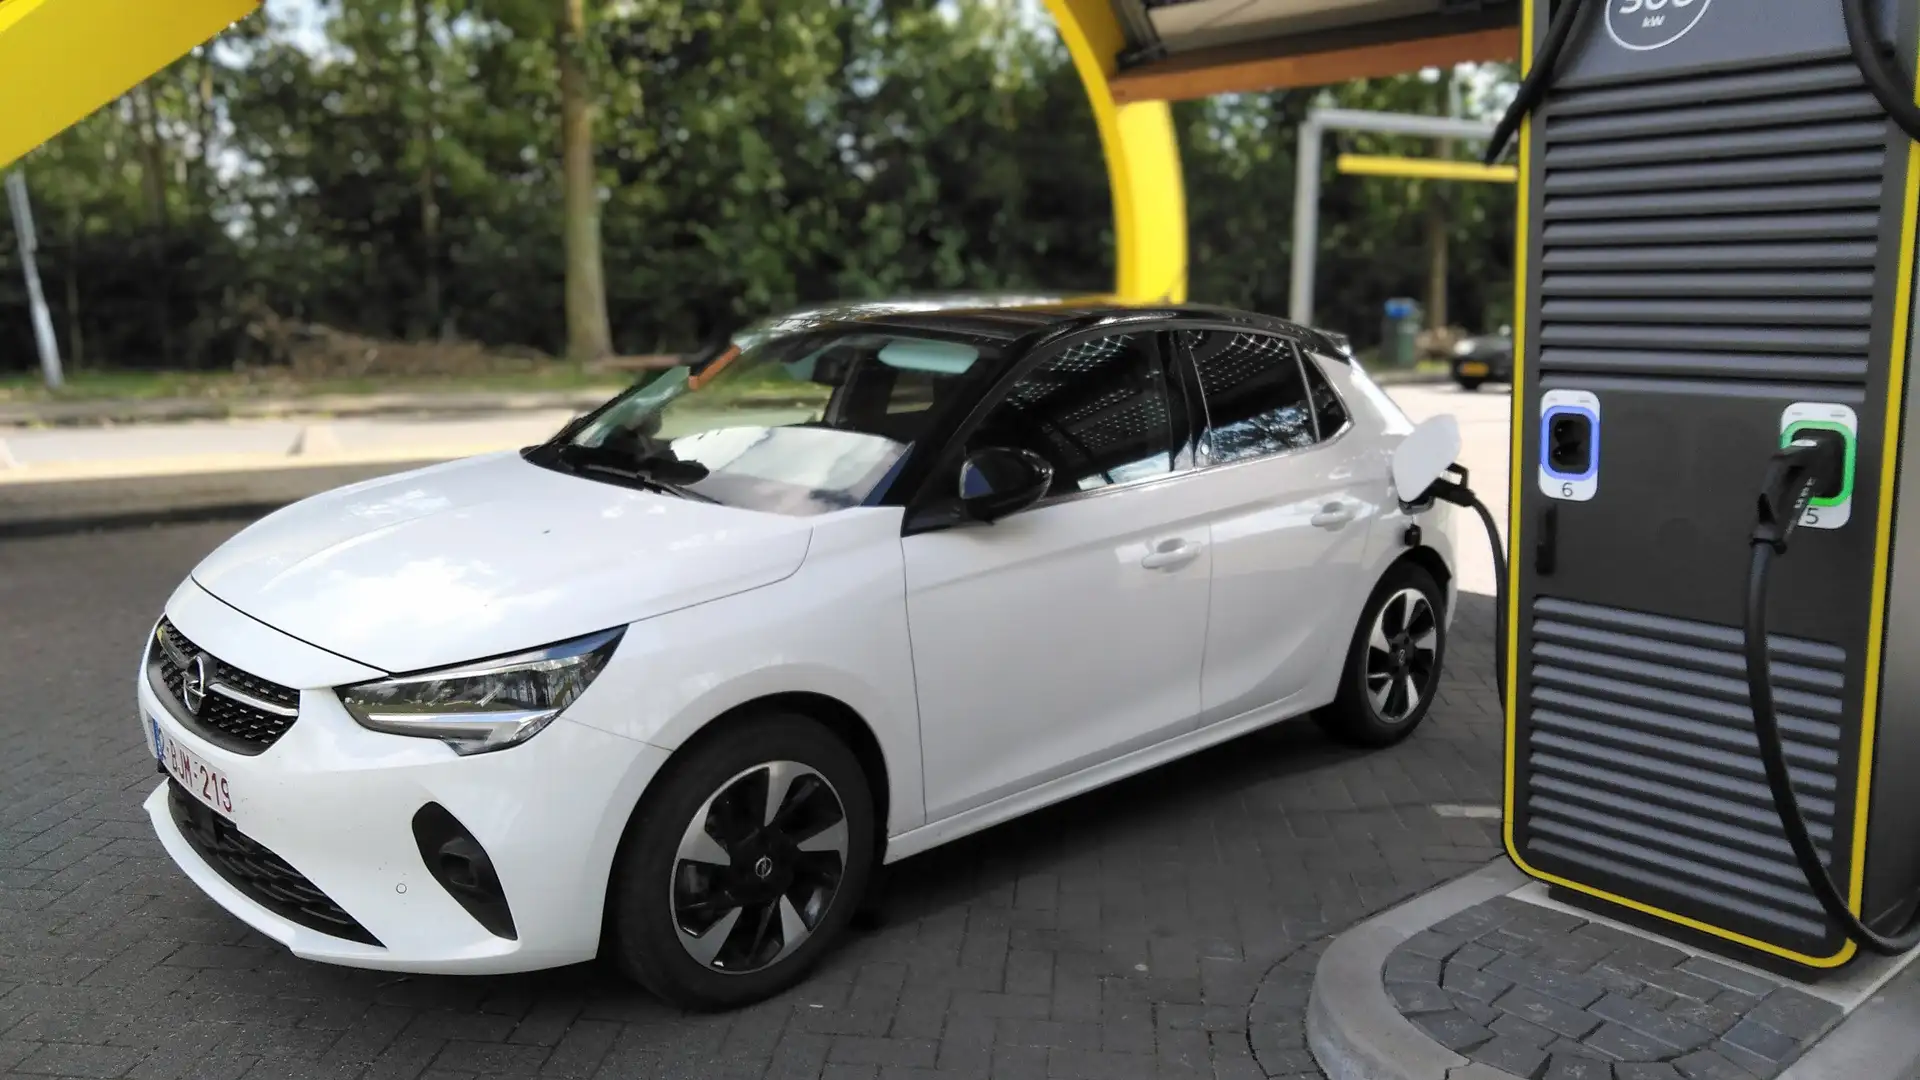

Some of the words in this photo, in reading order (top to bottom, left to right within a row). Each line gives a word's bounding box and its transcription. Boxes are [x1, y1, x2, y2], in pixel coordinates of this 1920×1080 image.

[1641, 14, 1666, 28] kW
[1562, 482, 1573, 497] 6
[1805, 507, 1819, 524] 5
